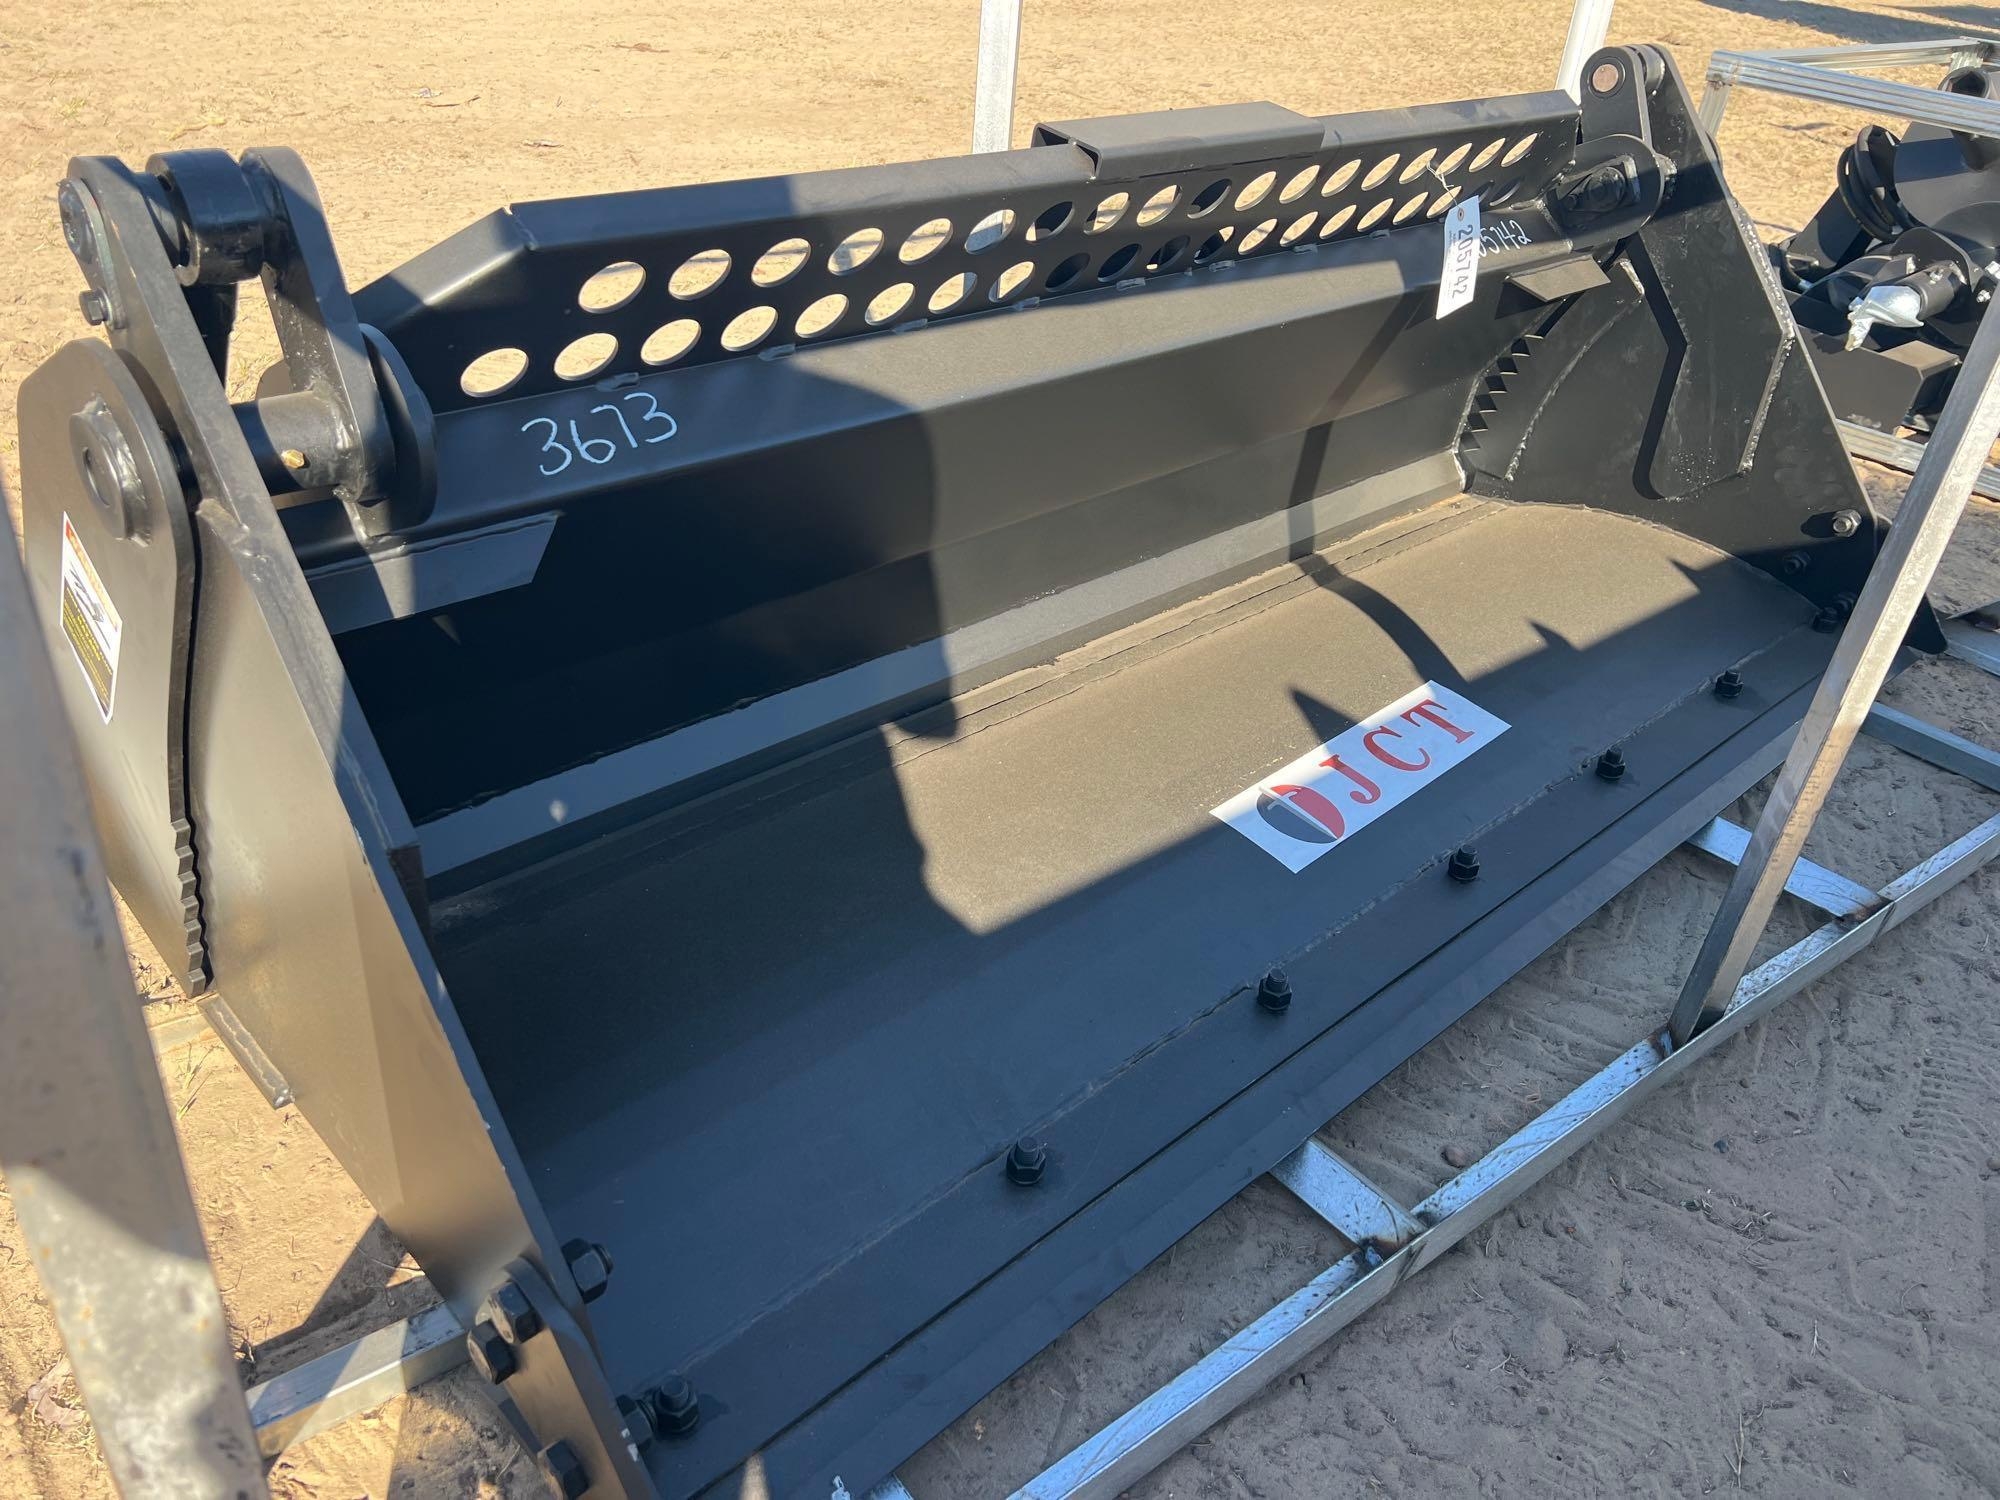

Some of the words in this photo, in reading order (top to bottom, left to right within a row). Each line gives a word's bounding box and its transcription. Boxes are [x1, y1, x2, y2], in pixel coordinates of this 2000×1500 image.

[1451, 224, 1474, 299] 205742
[521, 392, 678, 475] 3673
[1319, 699, 1475, 804] JCT
